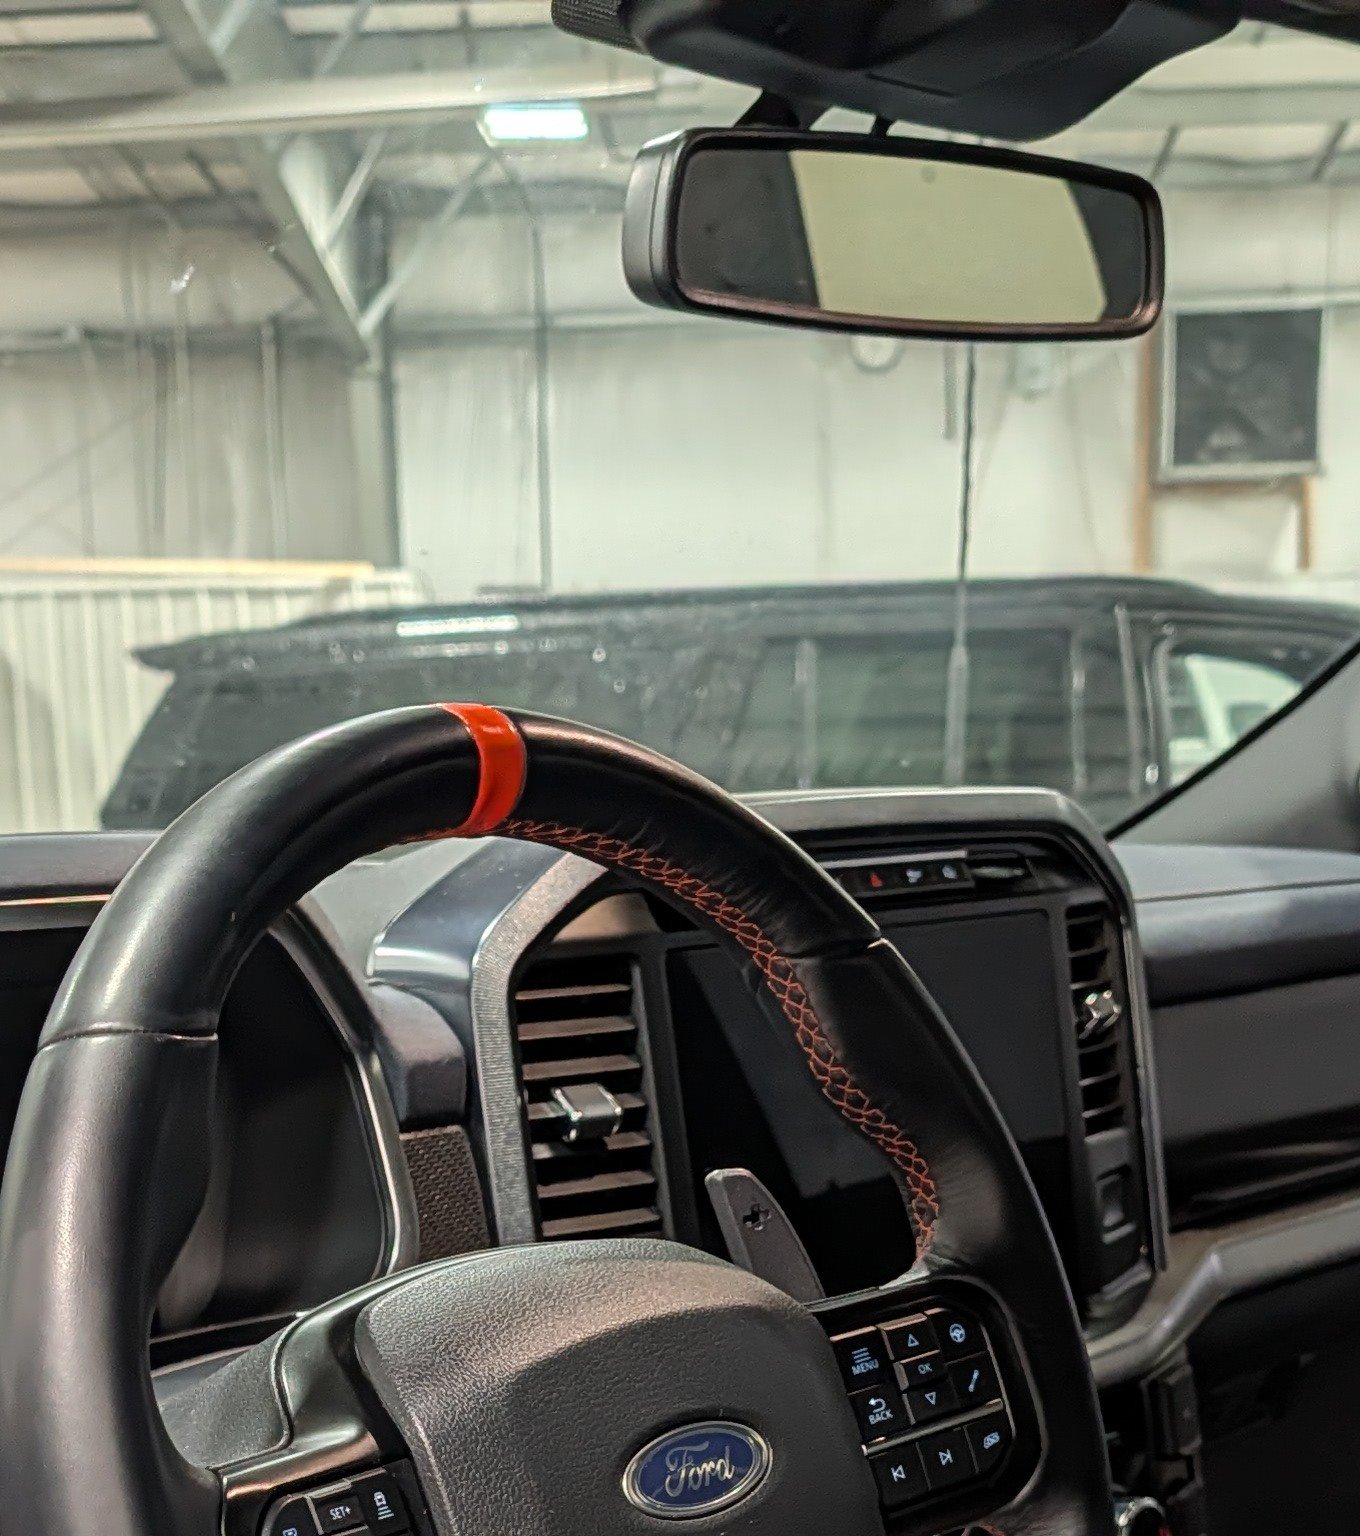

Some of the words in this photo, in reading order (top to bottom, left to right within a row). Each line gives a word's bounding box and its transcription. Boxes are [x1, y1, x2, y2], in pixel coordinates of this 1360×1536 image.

[851, 1359, 880, 1376] MENU
[917, 1363, 934, 1375] OK
[868, 1408, 894, 1425] BACK
[664, 1441, 735, 1498] Ford
[329, 1505, 352, 1521] SET+
